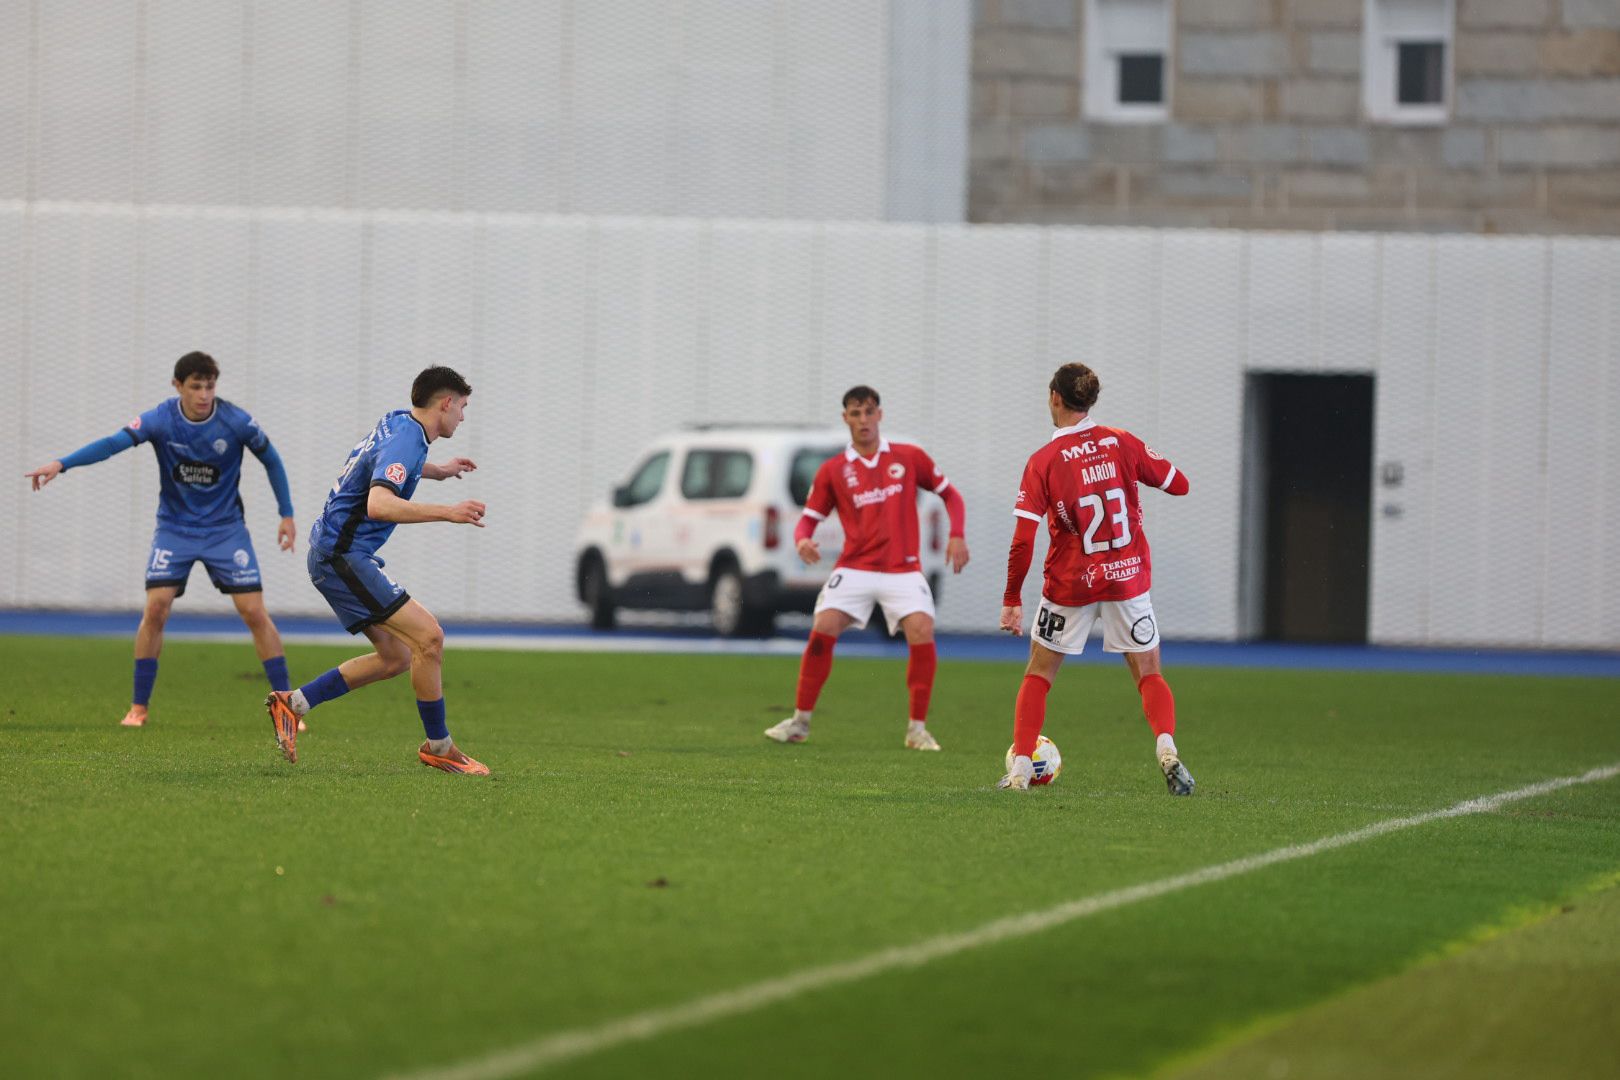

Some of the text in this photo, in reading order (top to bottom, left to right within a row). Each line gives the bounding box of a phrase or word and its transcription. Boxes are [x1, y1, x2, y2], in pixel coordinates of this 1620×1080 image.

[1082, 461, 1116, 485] AARÓN
[1078, 487, 1131, 555] 23
[152, 547, 174, 570] 15
[1100, 556, 1141, 572] TERNERA
[1104, 565, 1140, 580] CHARRA
